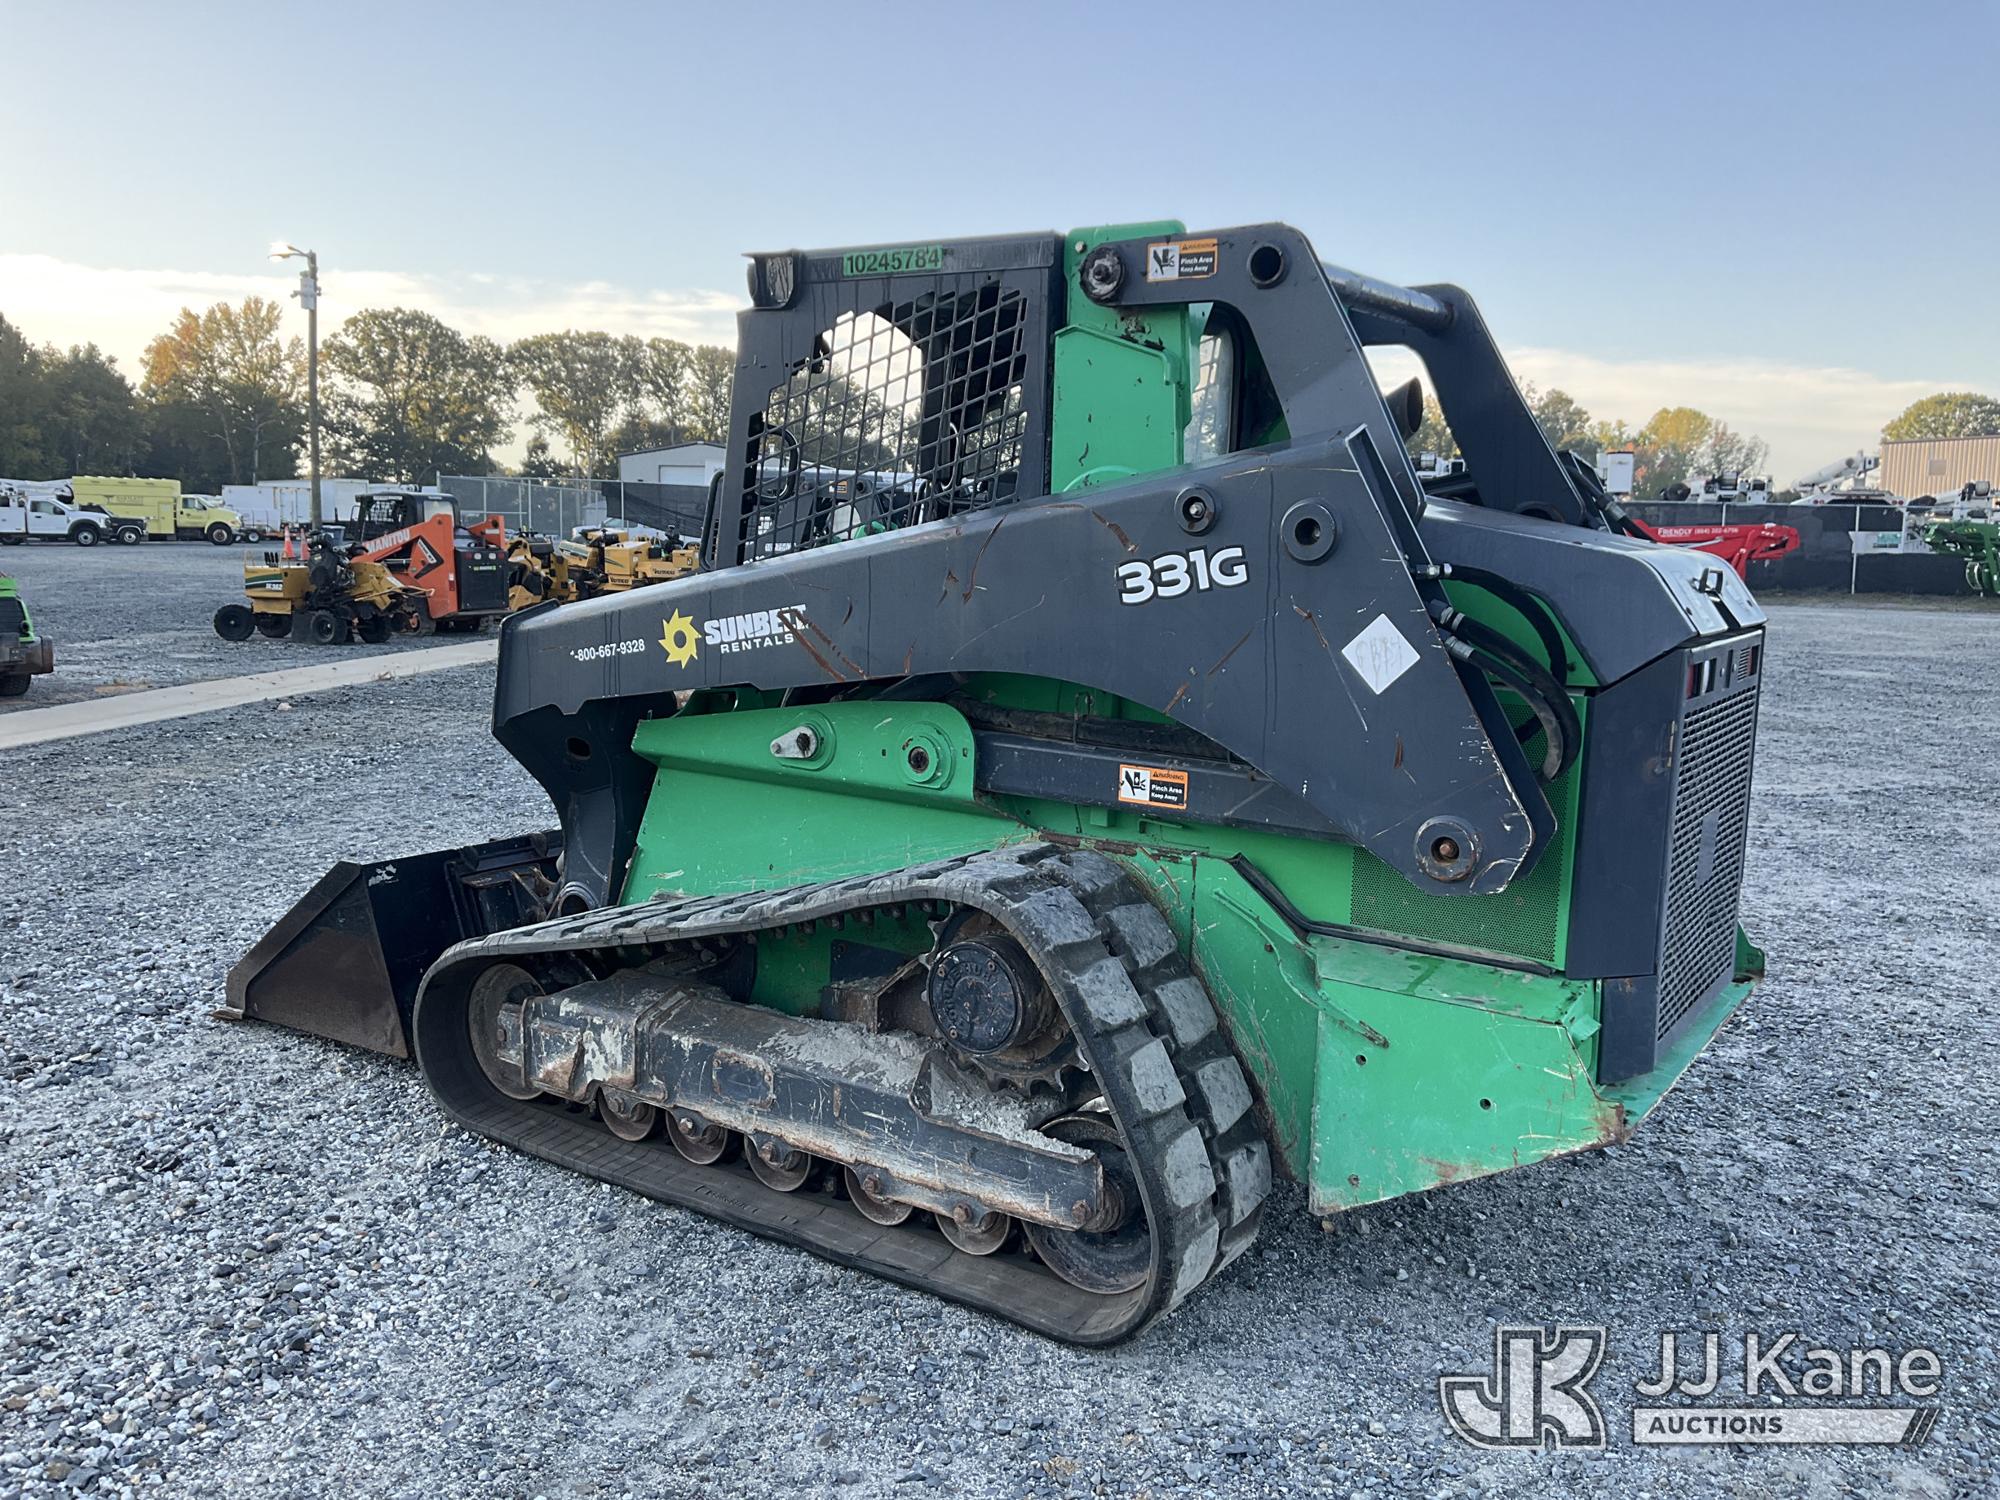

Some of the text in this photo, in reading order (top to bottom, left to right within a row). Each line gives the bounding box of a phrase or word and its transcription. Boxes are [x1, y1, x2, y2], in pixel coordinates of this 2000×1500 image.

[846, 248, 940, 274] 10245784
[1180, 255, 1214, 265] Pinch Area
[1180, 264, 1209, 273] Keep Away
[362, 528, 410, 552] MANITOU
[1657, 527, 1693, 536] FRIENDLY
[1117, 546, 1249, 605] 331G
[702, 604, 809, 646] SUNBELT
[569, 638, 646, 662] -800-667-9328
[719, 633, 796, 655] RENTALS
[1151, 784, 1167, 792] Pinch
